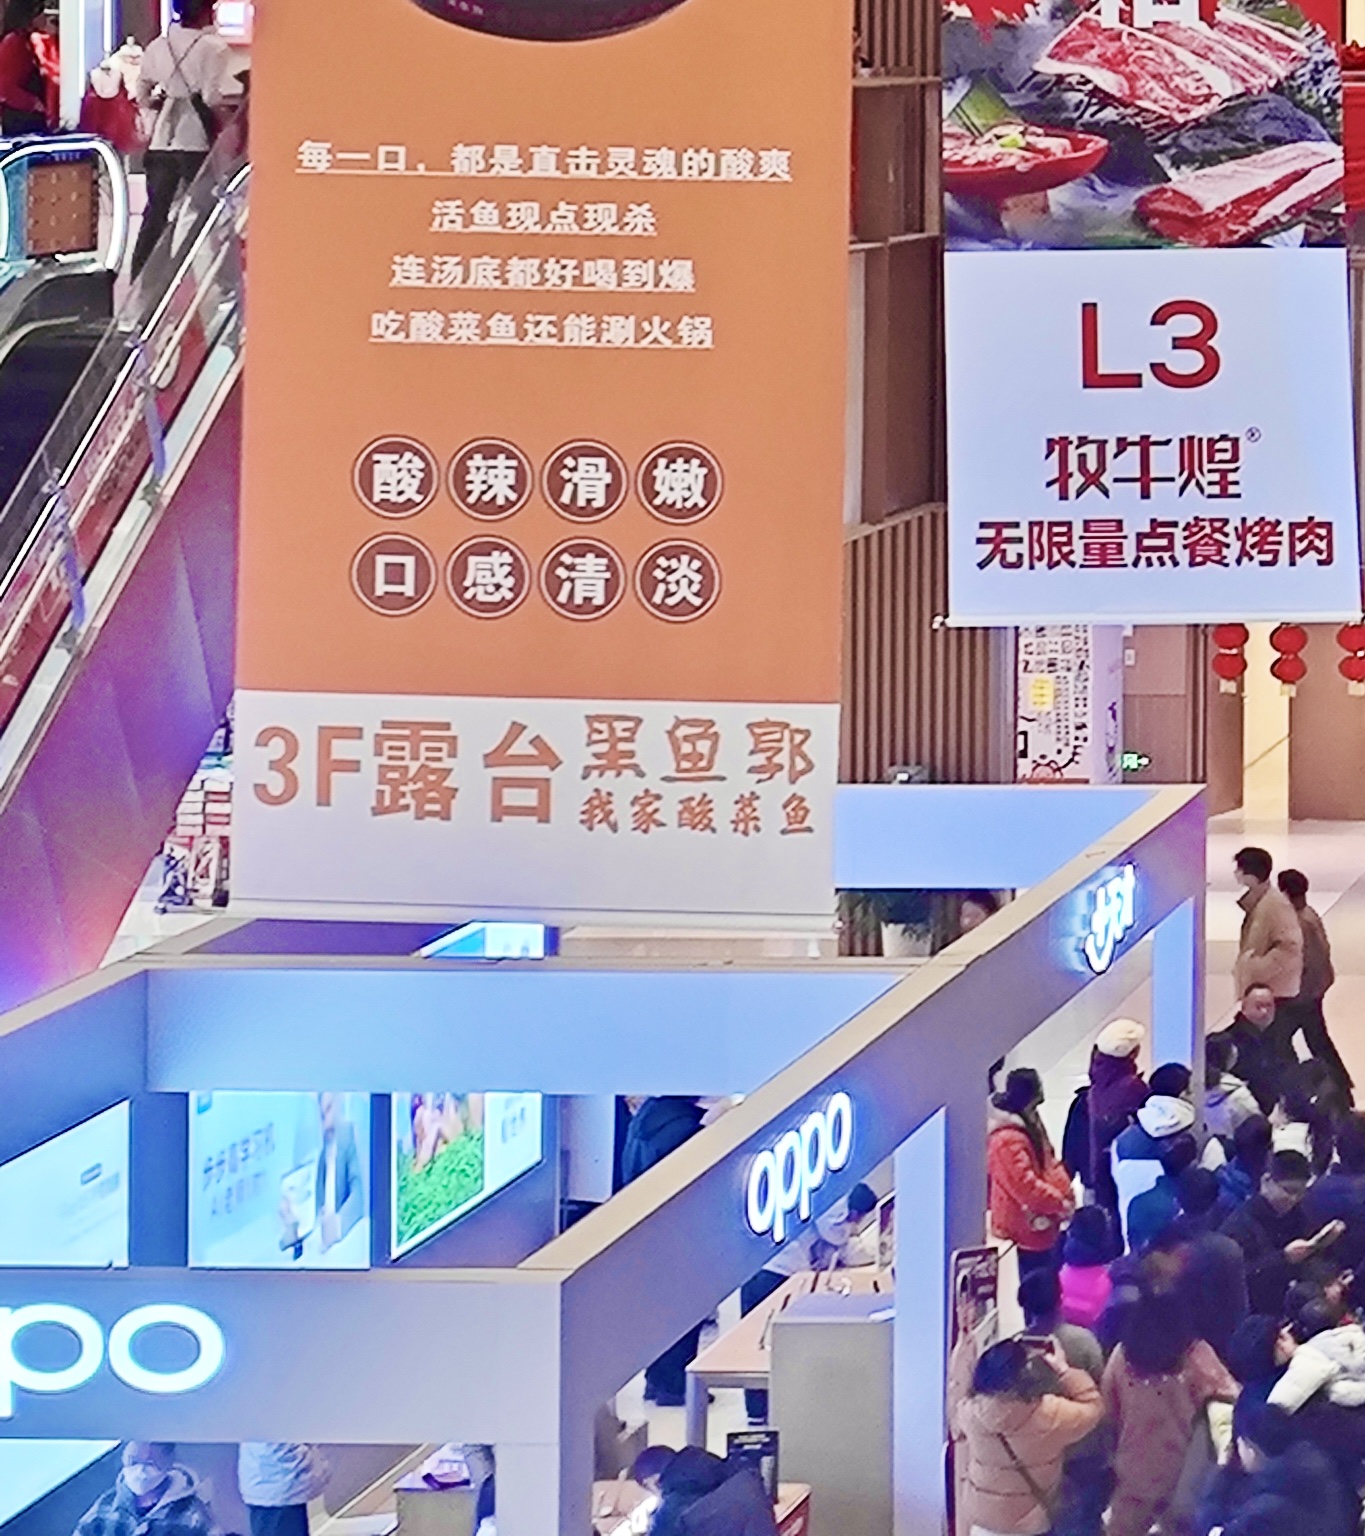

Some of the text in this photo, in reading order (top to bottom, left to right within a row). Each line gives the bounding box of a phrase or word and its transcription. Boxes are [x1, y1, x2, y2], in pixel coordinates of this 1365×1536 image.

[430, 200, 657, 233] 活鱼现点现杀
[390, 255, 697, 291] 连汤底都好喝到爆
[370, 312, 715, 347] 吃酸菜鱼还能涮火锅
[1080, 299, 1222, 390] L3
[974, 516, 1335, 571] 无限量点餐烤肉
[579, 788, 816, 836] 我家酸菜鱼
